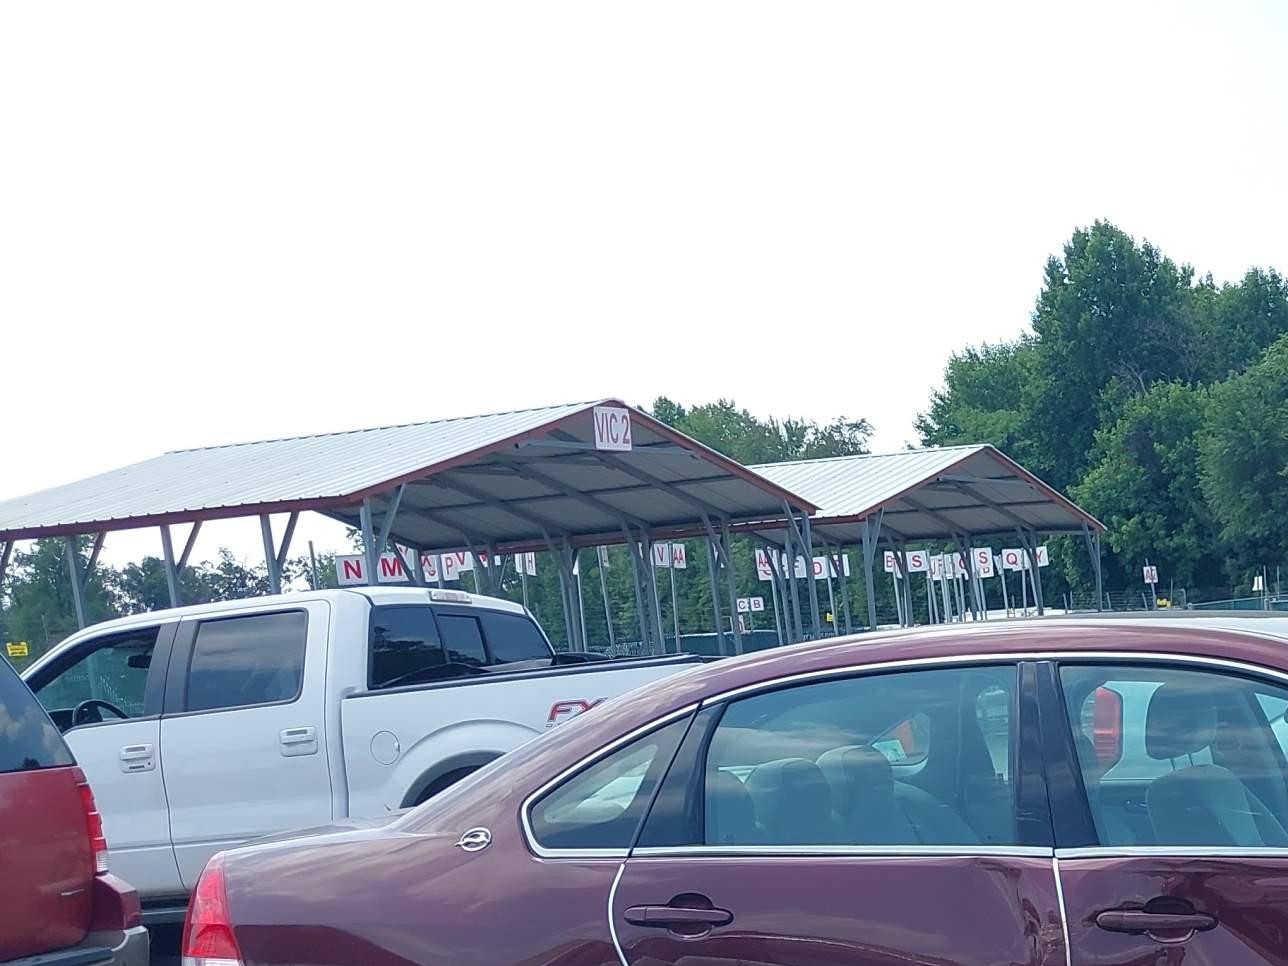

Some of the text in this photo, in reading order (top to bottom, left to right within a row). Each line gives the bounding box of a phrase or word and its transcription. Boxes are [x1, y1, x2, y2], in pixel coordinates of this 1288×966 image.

[595, 412, 630, 444] VIC 2
[912, 555, 922, 568] S
[979, 551, 988, 564] S
[1006, 552, 1018, 566] Q
[343, 559, 362, 579] N
[381, 558, 403, 577] M
[738, 600, 746, 610] C
[753, 600, 761, 608] B
